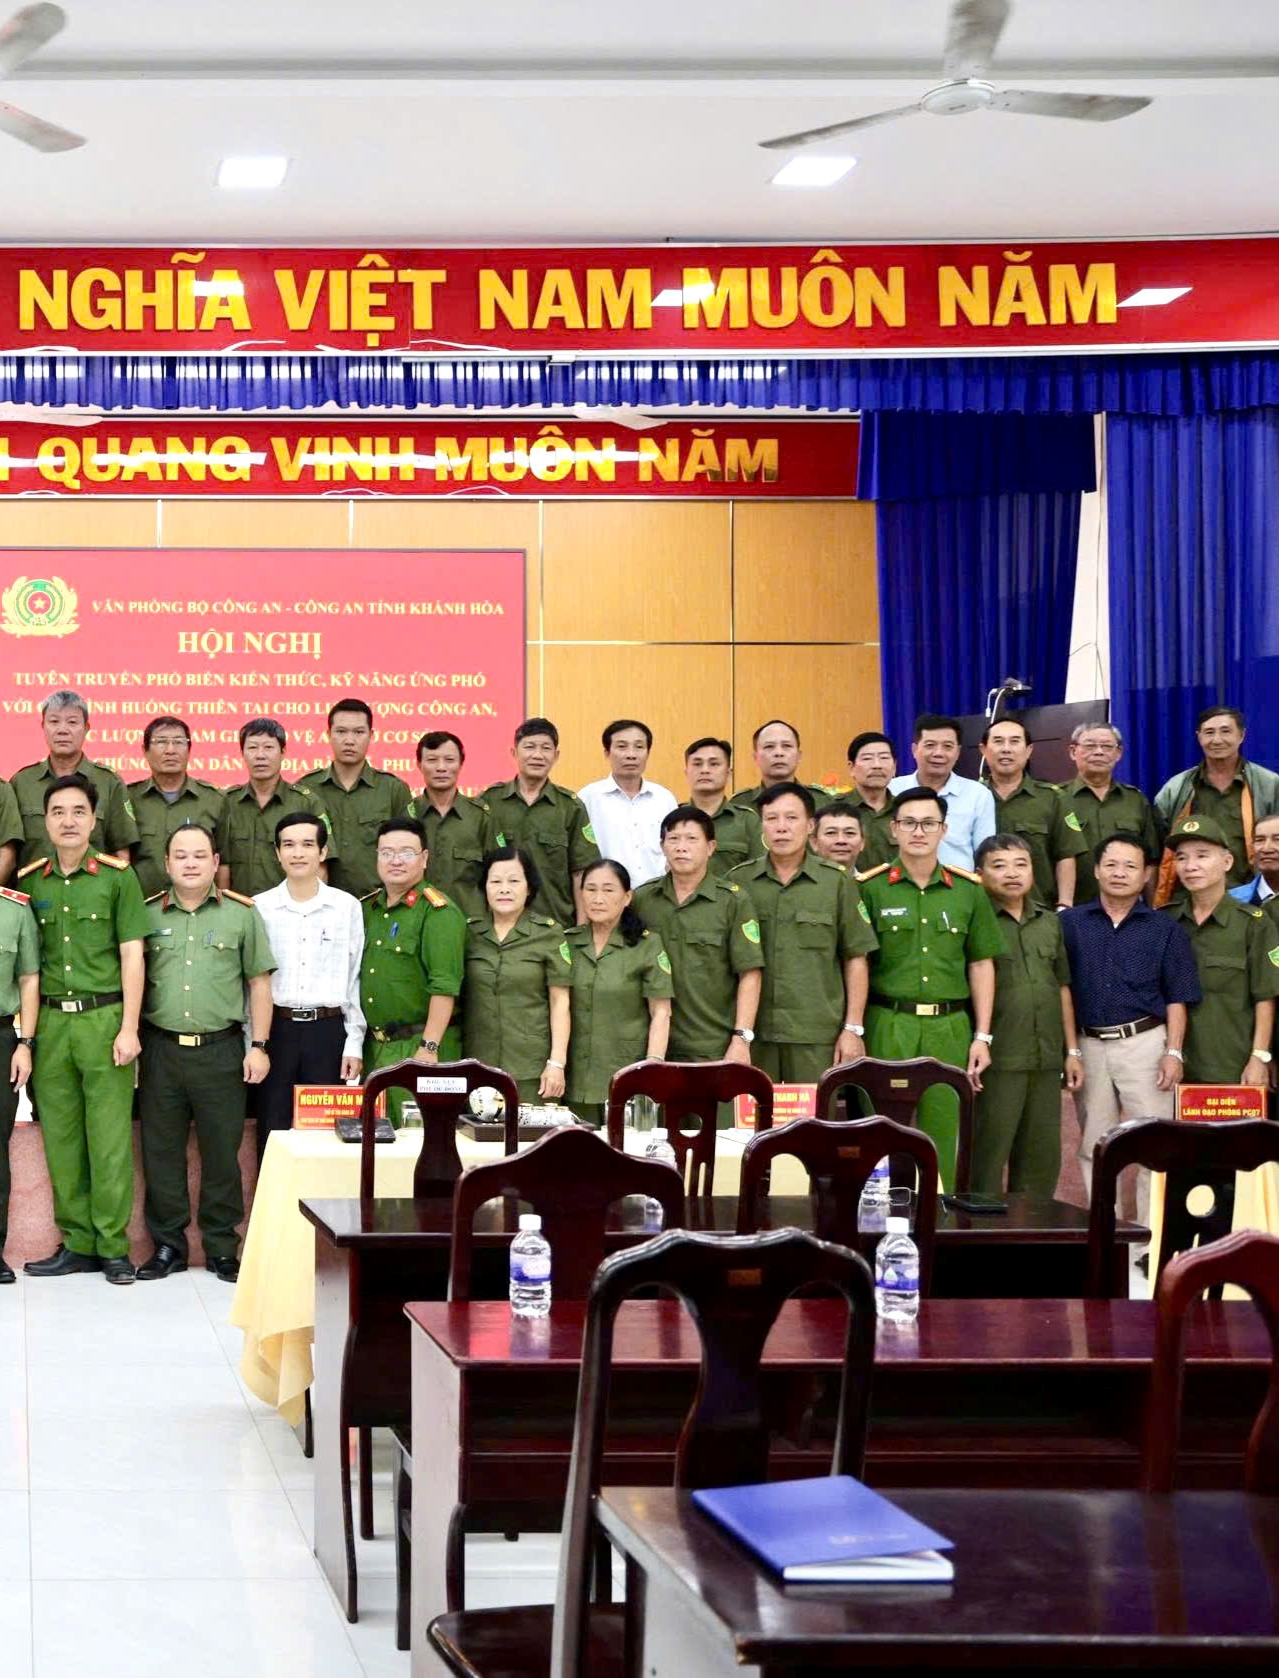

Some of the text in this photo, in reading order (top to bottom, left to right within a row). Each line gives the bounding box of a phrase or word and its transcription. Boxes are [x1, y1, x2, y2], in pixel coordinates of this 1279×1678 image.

[19, 252, 253, 333] NGHĨA
[274, 253, 447, 348] VIỆT
[479, 268, 653, 330] NAM
[682, 249, 906, 328] MUÔN
[939, 250, 1117, 326] NĂM
[39, 436, 251, 491] QUANG
[271, 437, 419, 483] VINH
[435, 425, 616, 483] MUÔN
[639, 428, 779, 483] NĂM
[92, 598, 124, 613] VĂN
[129, 598, 183, 613] PHÒNG
[187, 599, 209, 616] BỘ
[212, 599, 257, 614] CÔNG
[261, 602, 281, 614] AN
[294, 599, 339, 614] CÔNG
[342, 602, 364, 615] AN
[470, 600, 505, 615] HÒA
[178, 628, 323, 660] HỘI NGHỊ
[13, 669, 70, 685] TUYÊN
[358, 671, 406, 687] NĂNG
[2, 697, 33, 713] VỚI
[186, 698, 237, 714] THIÊN
[241, 702, 270, 714] TAI
[273, 702, 311, 715] CHO
[417, 700, 467, 715] CÔNG
[469, 703, 498, 717] AN,
[209, 755, 243, 771] DÂN
[336, 1092, 355, 1106] VĂN
